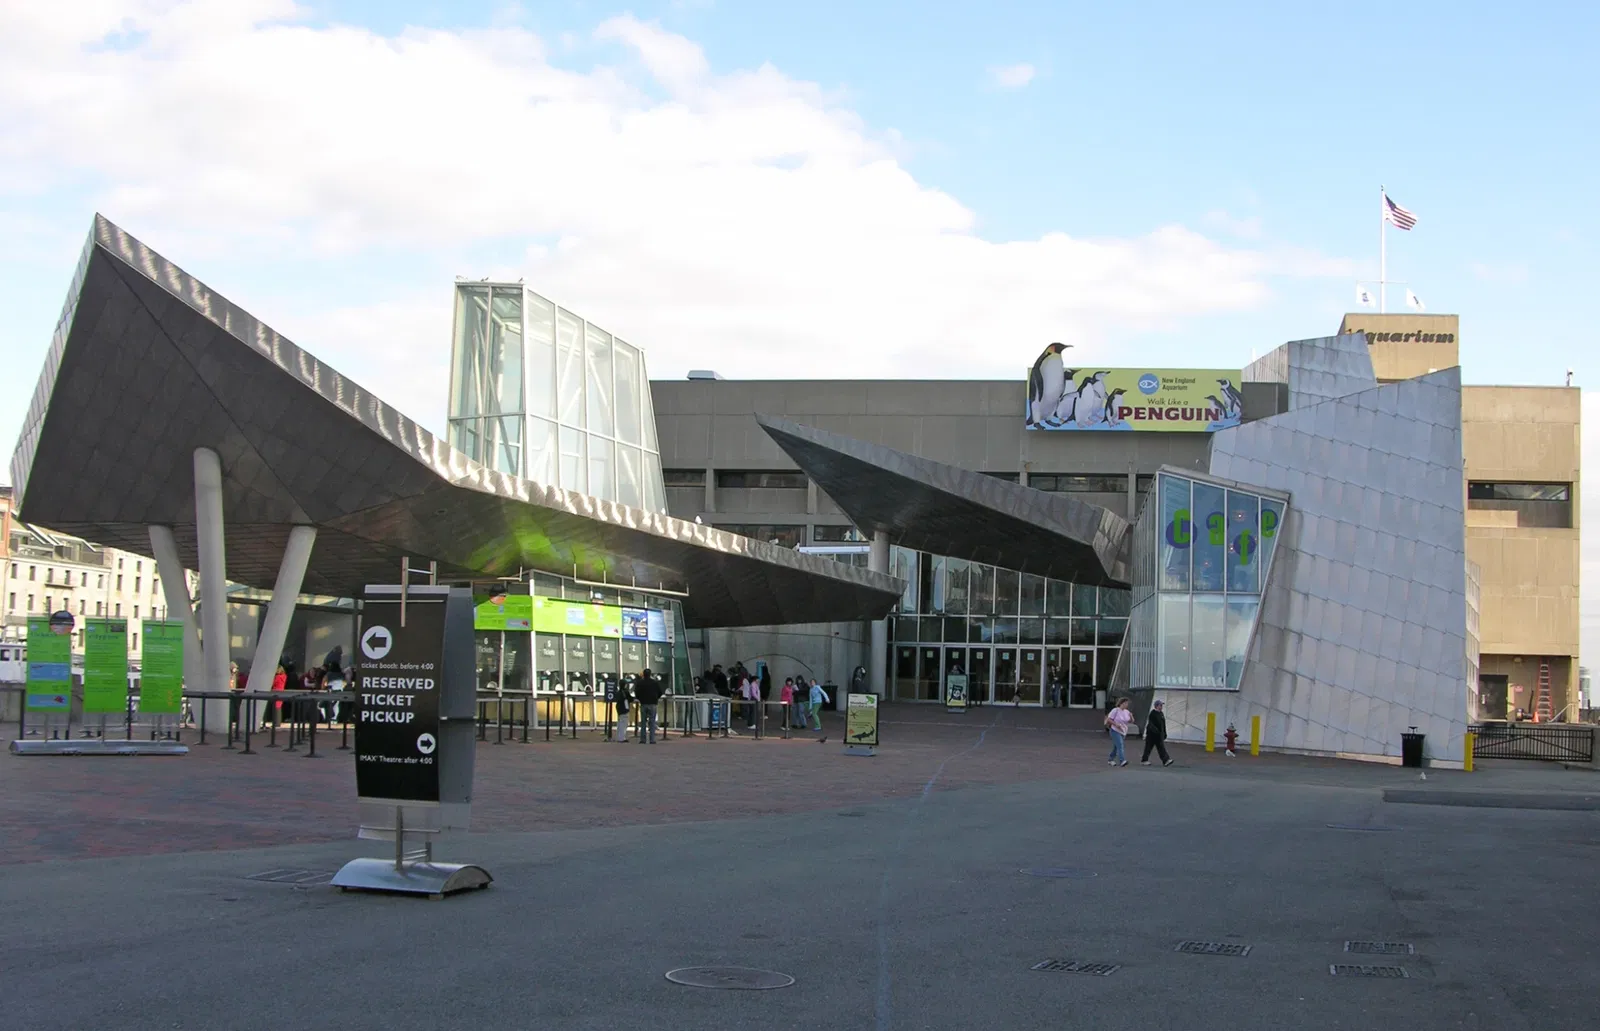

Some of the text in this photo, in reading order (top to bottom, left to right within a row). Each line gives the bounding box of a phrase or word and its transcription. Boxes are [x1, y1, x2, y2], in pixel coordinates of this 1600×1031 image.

[1118, 406, 1220, 421] PENGUIN
[362, 676, 434, 690] RESERVED
[361, 694, 415, 706] TICKET
[361, 711, 414, 723] PICKUP
